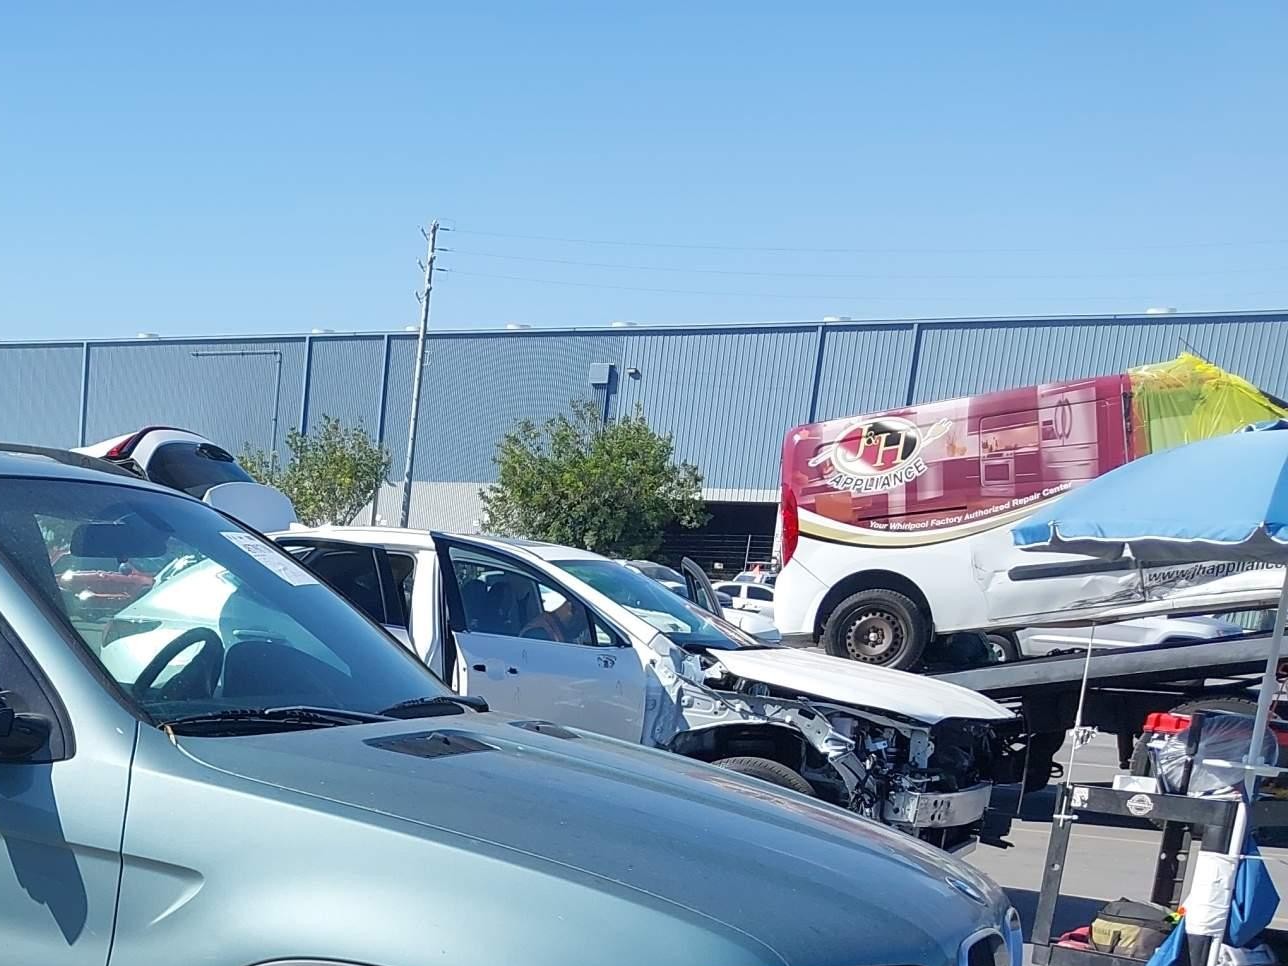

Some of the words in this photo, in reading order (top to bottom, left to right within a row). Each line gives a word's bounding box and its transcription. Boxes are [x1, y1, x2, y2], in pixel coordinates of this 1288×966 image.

[851, 424, 908, 467] J&H
[829, 459, 926, 491] APPLIANCE
[868, 519, 889, 529] Your
[889, 520, 929, 531] Whirlpool
[930, 514, 963, 528] Factory
[963, 500, 1011, 521] Authorized
[1012, 492, 1041, 508] Repair
[1042, 481, 1073, 498] Center
